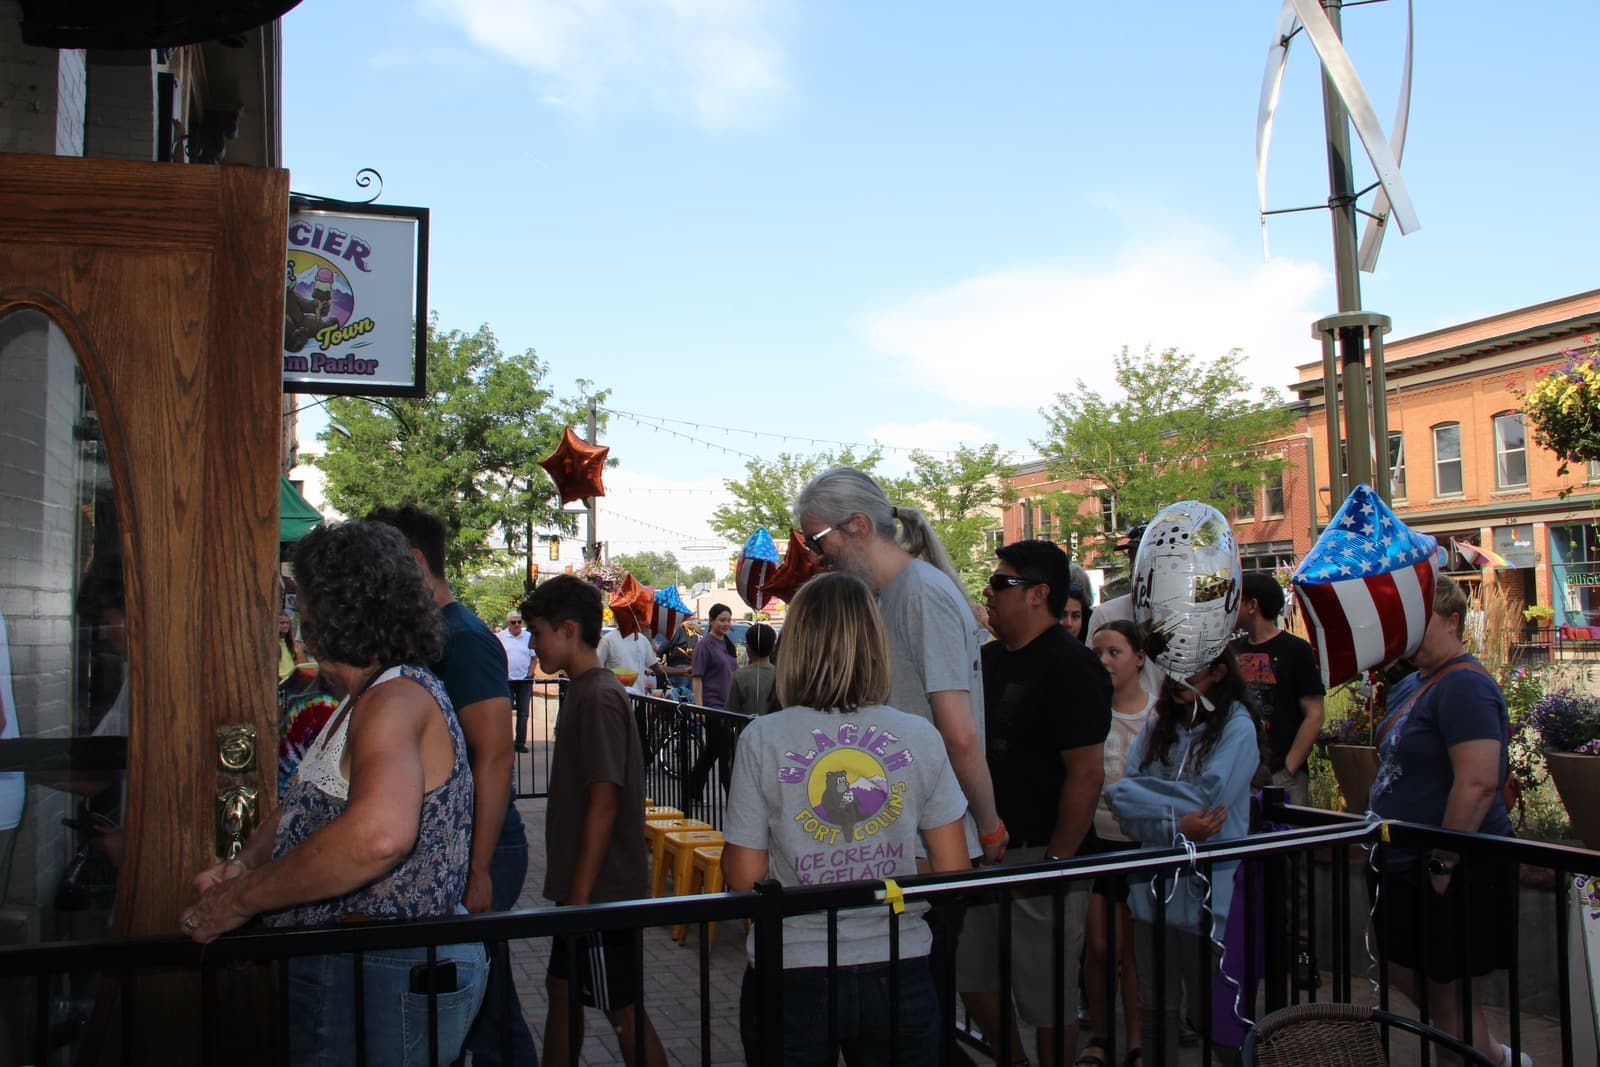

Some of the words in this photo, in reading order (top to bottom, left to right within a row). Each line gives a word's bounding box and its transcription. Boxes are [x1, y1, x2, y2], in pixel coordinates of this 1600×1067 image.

[288, 221, 372, 272] CIER
[316, 317, 375, 350] Town
[311, 353, 379, 375] Parlor
[777, 723, 914, 784] GLACIER
[793, 810, 841, 845] FORT
[854, 781, 907, 841] COLLINS
[794, 852, 825, 872] ICE
[830, 843, 903, 867] CREAM
[800, 873, 813, 886] &
[819, 860, 896, 884] GELATO
